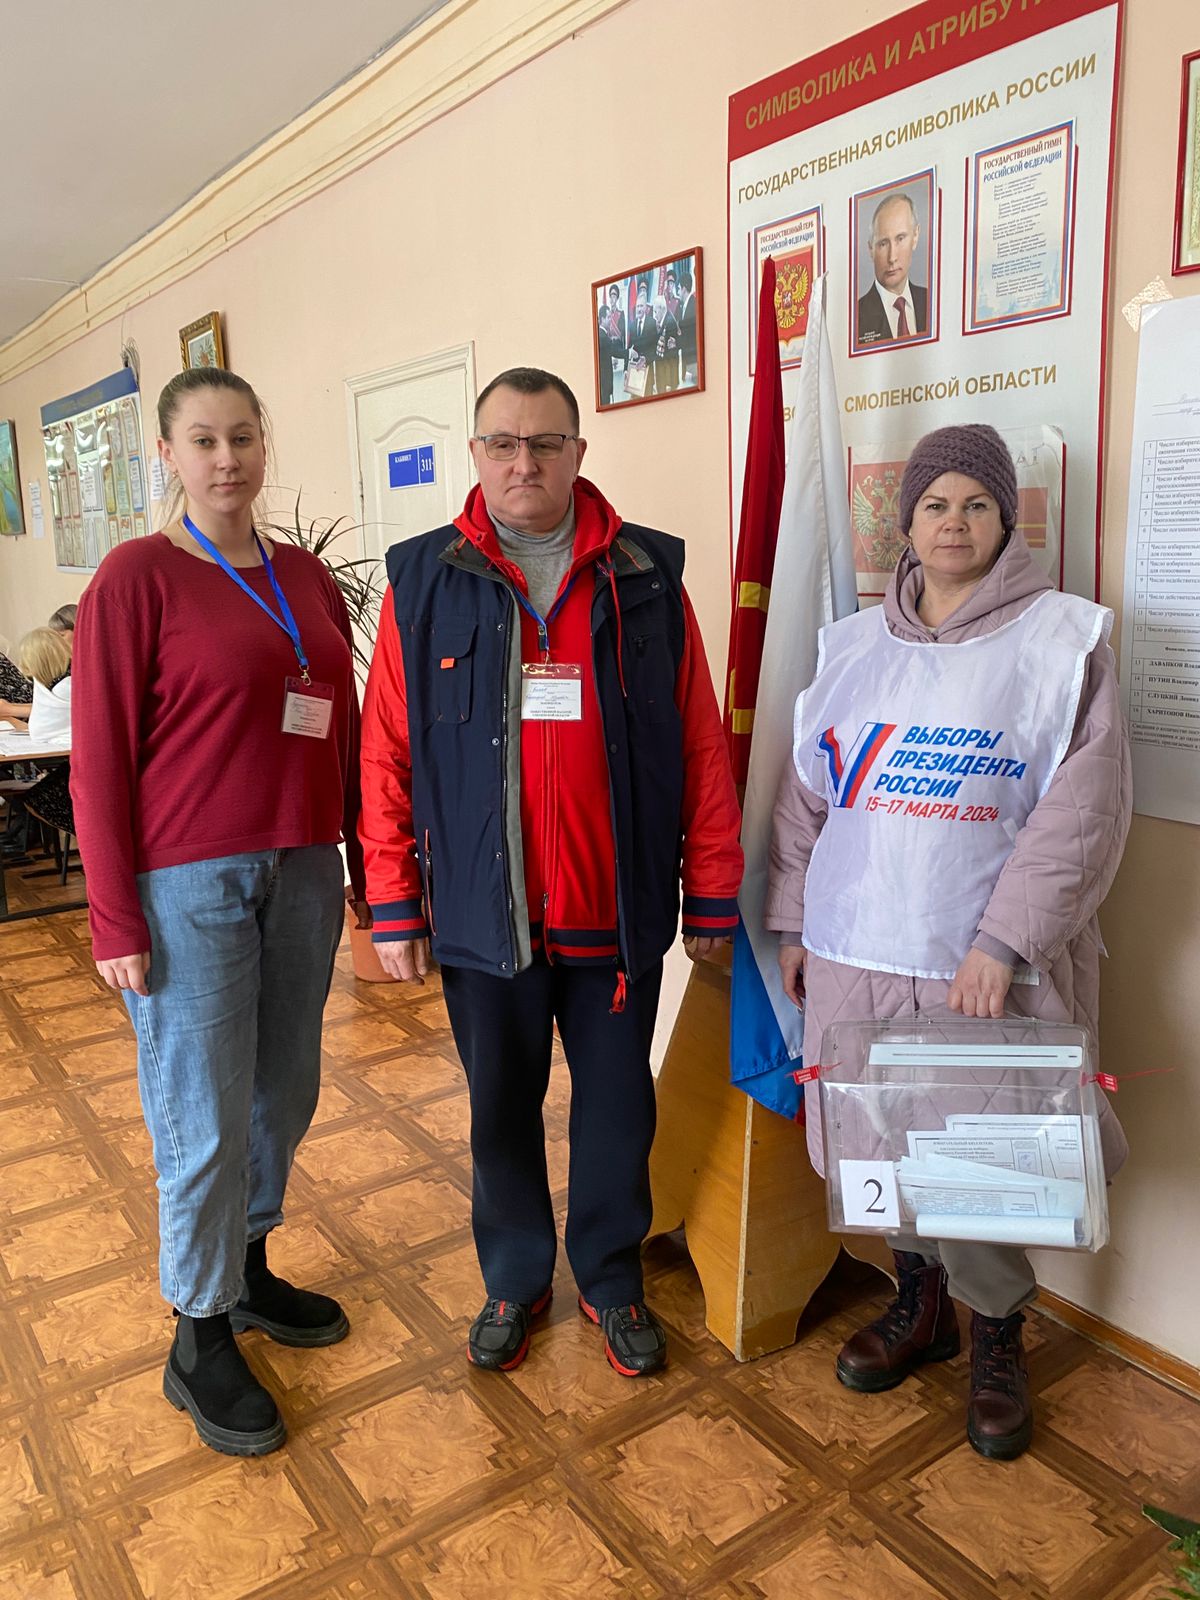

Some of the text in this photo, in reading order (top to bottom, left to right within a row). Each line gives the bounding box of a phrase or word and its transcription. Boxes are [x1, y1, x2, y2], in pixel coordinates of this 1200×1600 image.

[745, 0, 1041, 131] СИМВОЛИКА И АТРИБУ
[738, 53, 1097, 204] ГОСУДАРСТВЕННАЯ СИМВОЛИКА РОССИИ
[983, 150, 1062, 183] РОССИЙСКОЙ ФЕДЕРАЦИИ
[984, 137, 1062, 170] ГОСУДАРСТВЕННЫЙ ГИМН
[760, 222, 803, 243] ГОСУДАРСТВЕННЫЙ
[760, 231, 815, 253] РОССИЙСКОЙ ФЕДЕРАЦИИ
[844, 376, 959, 413] СМОЛЕНСКОЙ
[964, 364, 1057, 396] ОБЛАСТИ
[421, 458, 432, 472] 311
[902, 725, 1004, 750] ВЫБОРЫ
[886, 749, 1027, 780] ПРЕЗИДЕНТА
[873, 773, 963, 798] РОССИИ
[904, 800, 960, 820] МАРТА
[960, 806, 999, 822] 2024
[863, 1178, 887, 1214] 2
